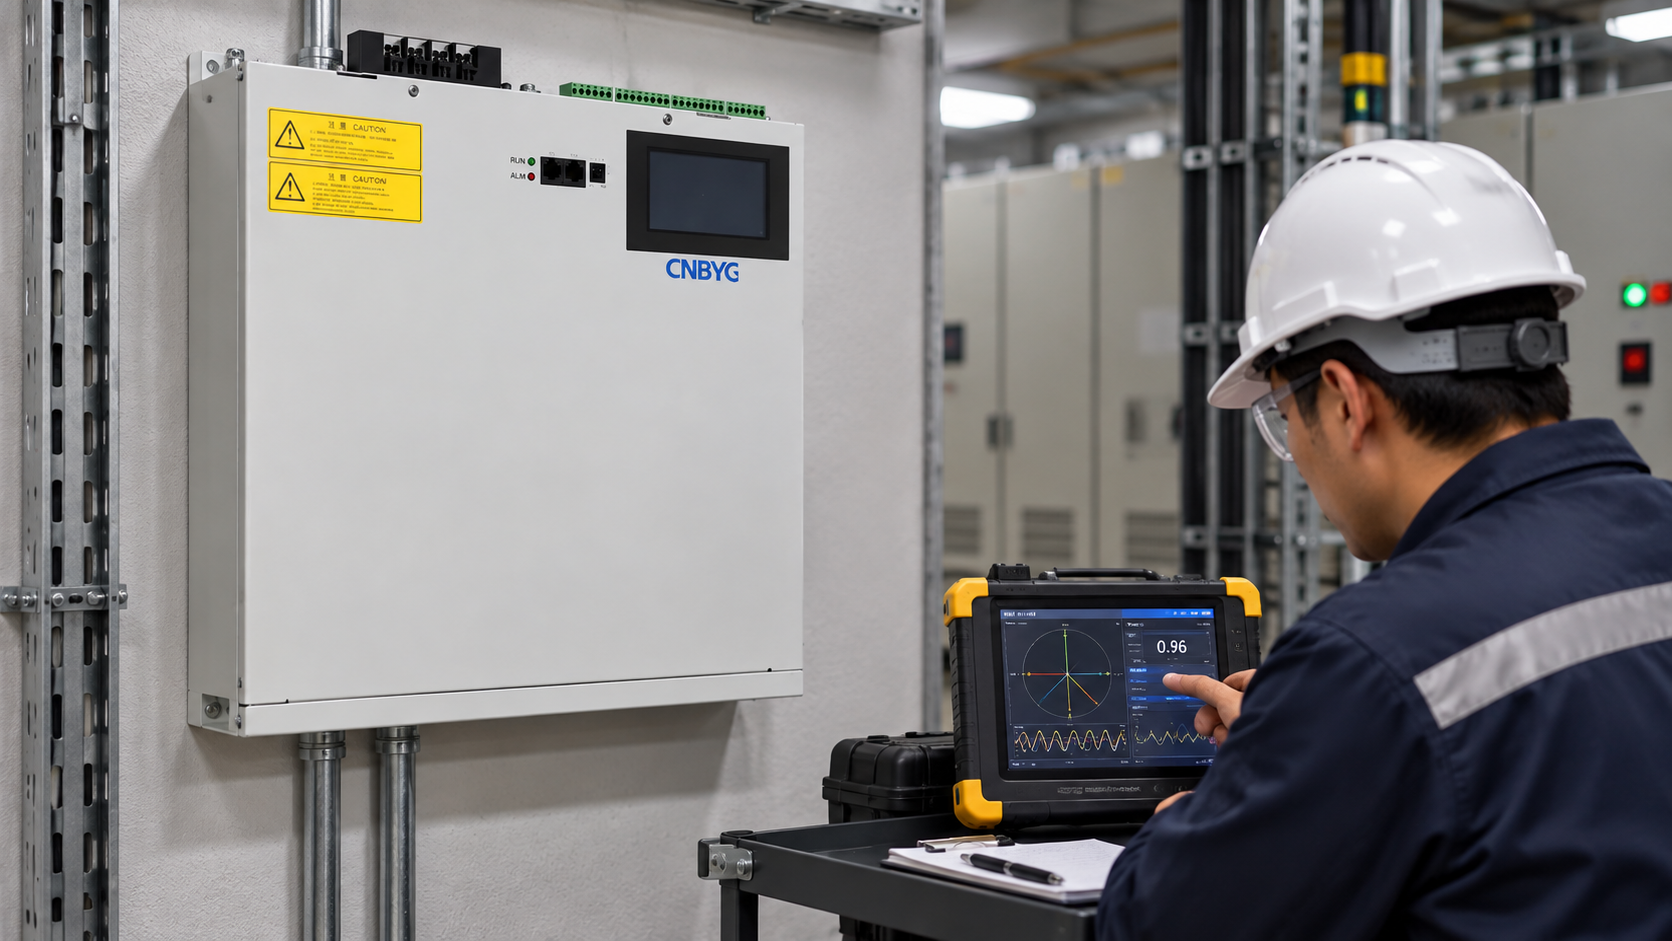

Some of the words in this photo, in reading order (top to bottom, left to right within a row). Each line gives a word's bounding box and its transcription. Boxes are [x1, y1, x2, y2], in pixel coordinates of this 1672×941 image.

[510, 156, 526, 165] RUN
[510, 172, 526, 180] ALM
[665, 258, 739, 283] CNBYG
[1156, 640, 1188, 654] 0.96
